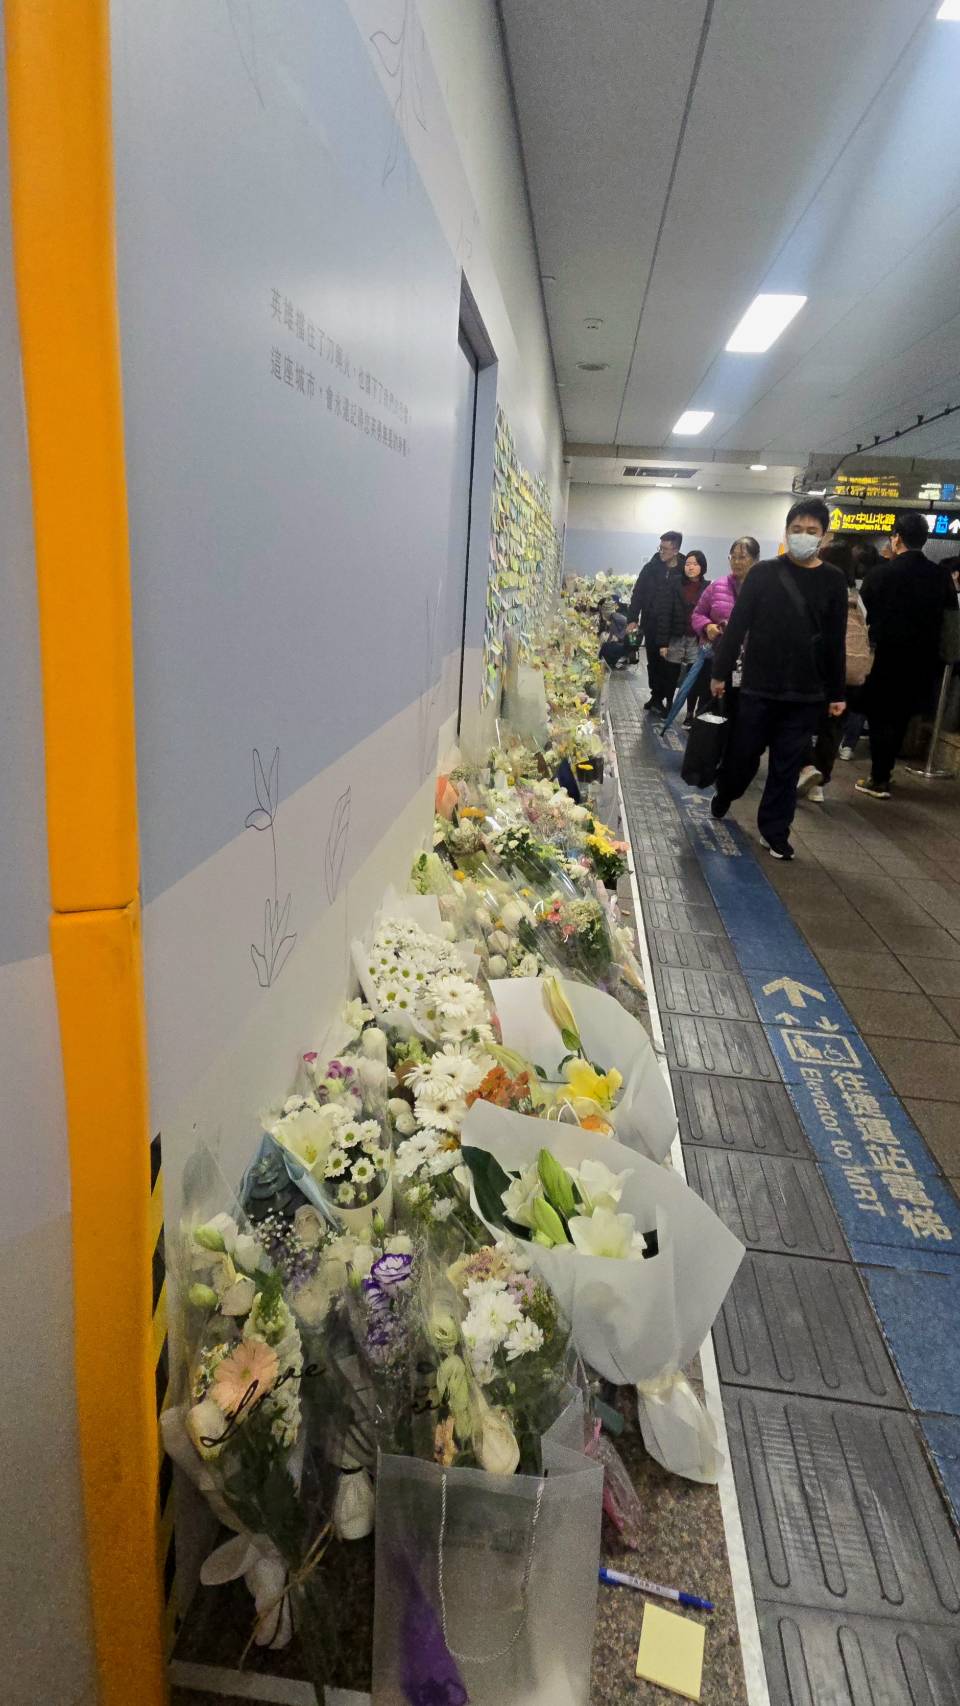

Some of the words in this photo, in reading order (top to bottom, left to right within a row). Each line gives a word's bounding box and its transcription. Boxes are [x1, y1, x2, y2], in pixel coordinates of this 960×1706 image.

[842, 514, 855, 523] M7
[856, 512, 896, 525] 中山北路
[842, 523, 874, 531] Zhongshan
[799, 1067, 844, 1137] Elevator
[830, 1139, 853, 1159] to
[842, 1163, 886, 1218] MRT
[829, 1069, 953, 1241] 往捷運站電梯
